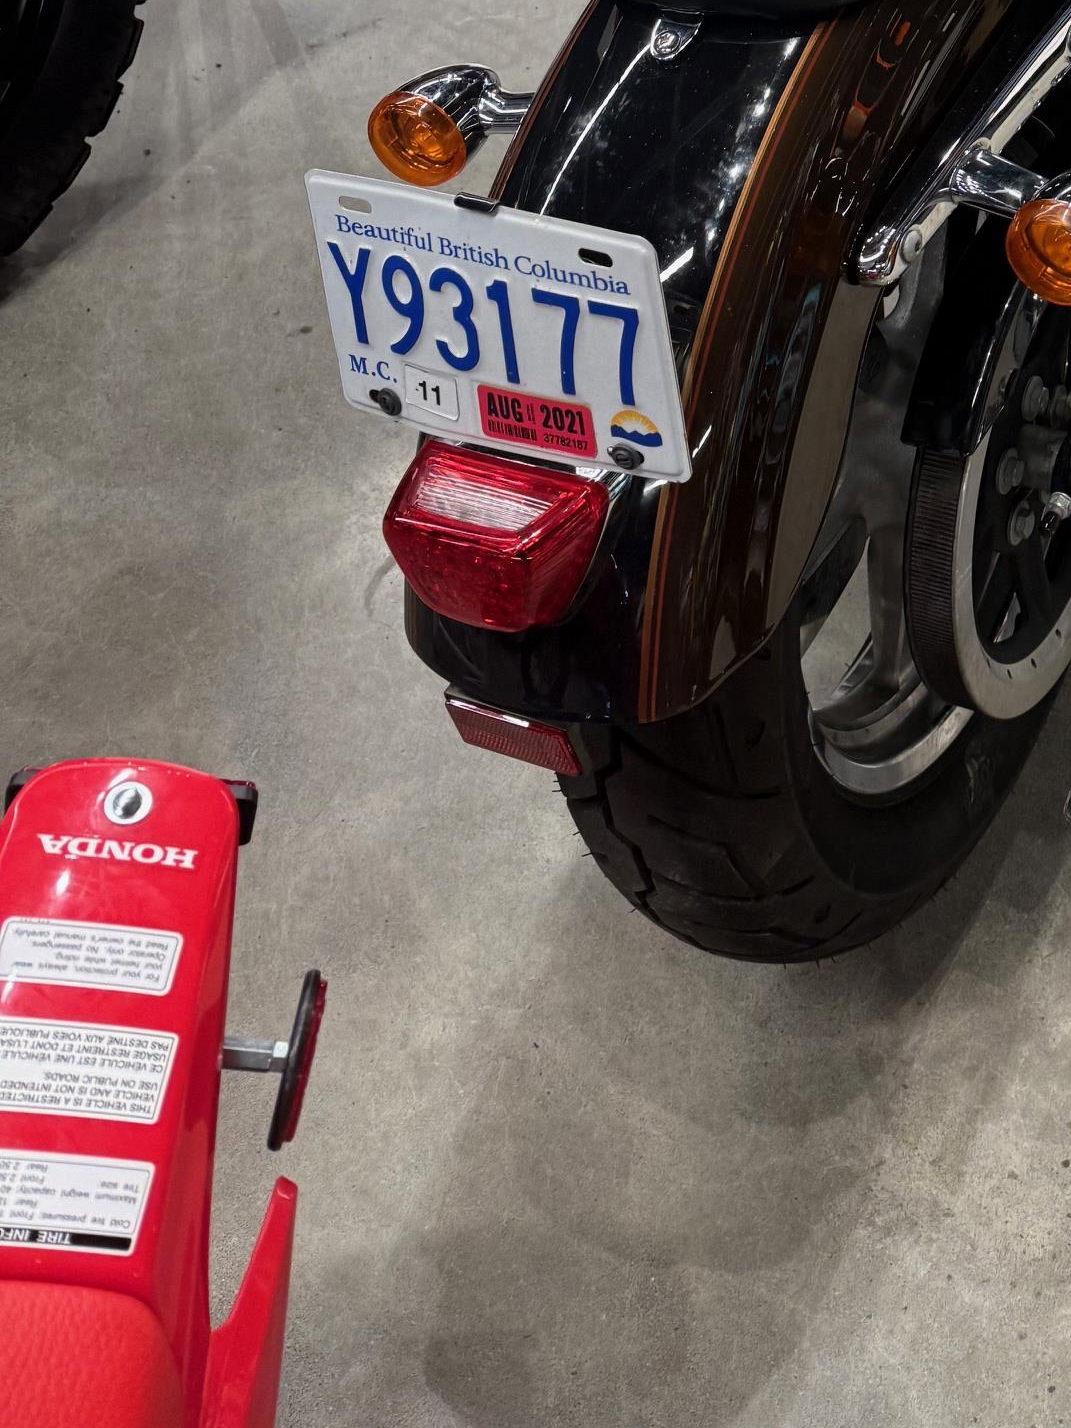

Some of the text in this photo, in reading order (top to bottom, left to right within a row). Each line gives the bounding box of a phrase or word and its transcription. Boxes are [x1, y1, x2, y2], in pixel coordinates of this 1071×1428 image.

[334, 214, 632, 296] Beautiful British Columbia
[326, 241, 640, 407] Y93177
[349, 353, 398, 384] M.C.
[416, 380, 442, 406] 11
[487, 392, 586, 436] AUG 2021
[36, 833, 199, 869] HONDA
[54, 932, 87, 942] manual
[90, 935, 124, 944] owner's
[128, 938, 141, 948] the
[145, 941, 169, 951] Read
[86, 945, 99, 954] No
[84, 955, 106, 965] while
[128, 949, 166, 962] Operator
[38, 962, 68, 972] always
[111, 958, 140, 969] helmet
[144, 961, 163, 970] your
[122, 970, 141, 979] your
[145, 973, 160, 984] For
[52, 1031, 82, 1042] VOIES
[85, 1033, 105, 1044] AUX
[31, 1040, 59, 1052] DONT
[61, 1042, 73, 1052] ET
[75, 1045, 130, 1058] RESTREINT
[150, 1041, 169, 1052] PAS
[53, 1053, 75, 1064] UNE
[78, 1056, 96, 1067] EST
[132, 1050, 167, 1062] USAGE
[149, 1063, 164, 1074] CE
[82, 1074, 118, 1087] PUBLIC
[121, 1077, 137, 1088] ON
[140, 1080, 158, 1091] USE
[0, 1079, 155, 1103] VEHICLE AND IS NOT INTENDED
[0, 1091, 151, 1114] THIS VEHICLE IS A RESTRICTED
[0, 1172, 17, 1183] 2.5
[60, 1189, 90, 1199] weight
[122, 1183, 140, 1194] Tire
[95, 1193, 137, 1205] Maximum
[91, 1216, 105, 1225] tire
[110, 1218, 131, 1229] Cold
[37, 1231, 72, 1245] TIRE
